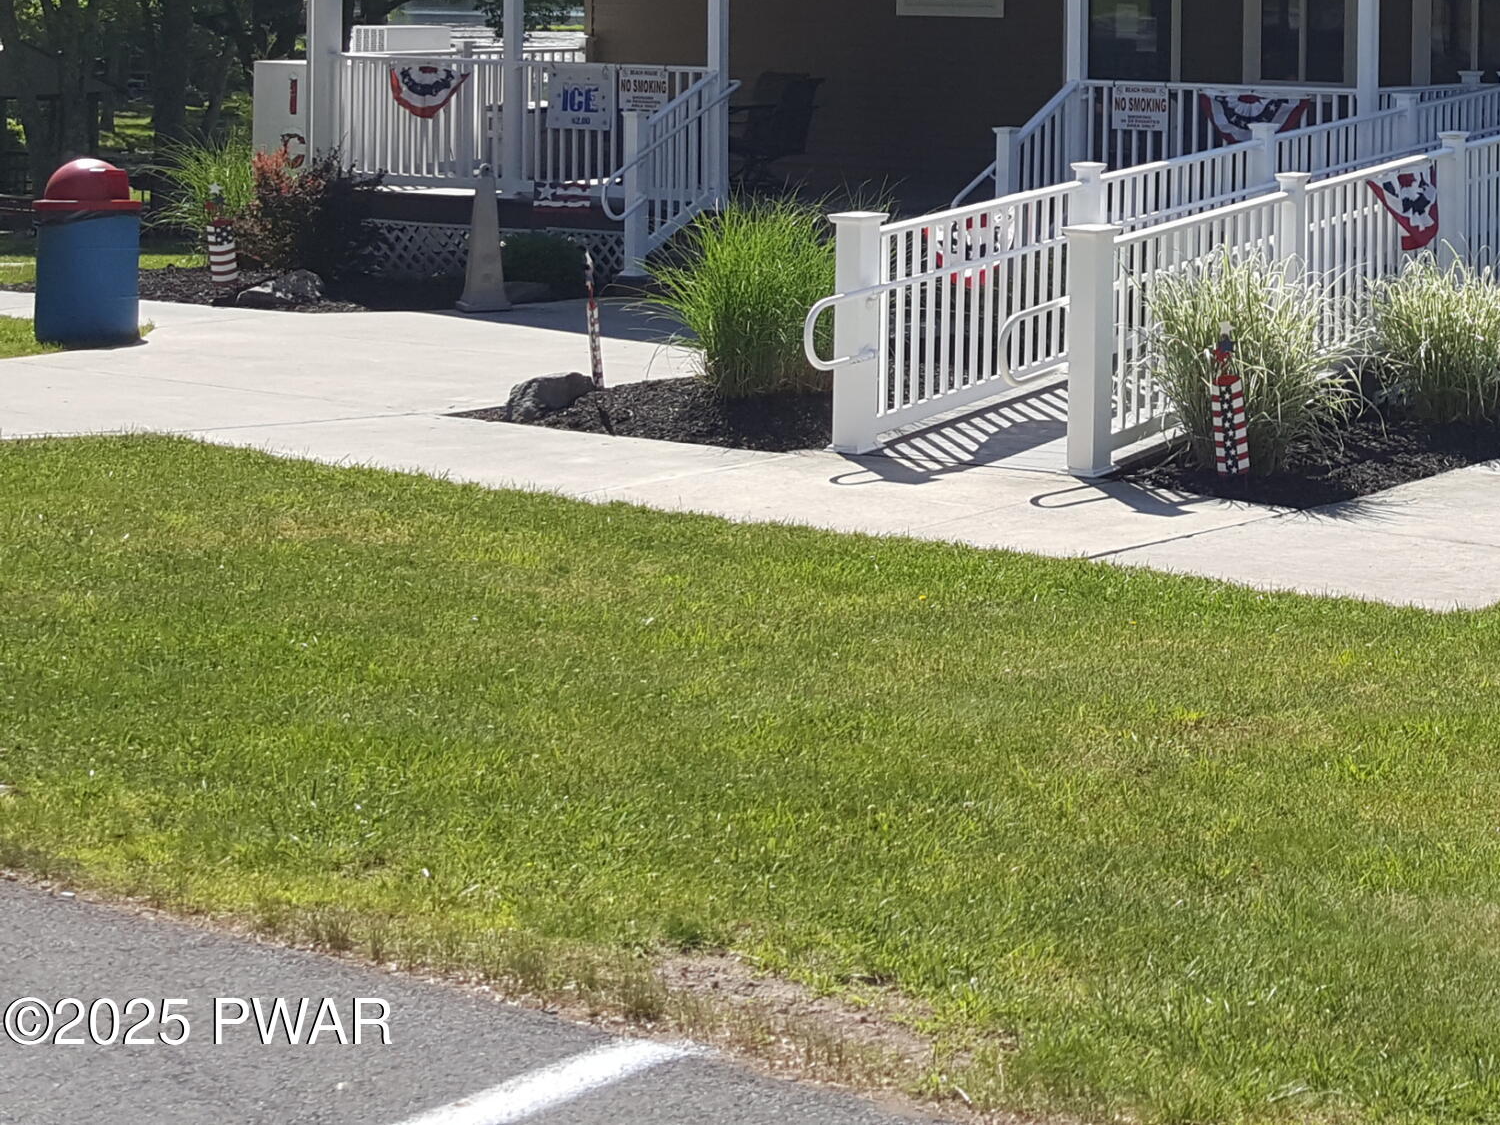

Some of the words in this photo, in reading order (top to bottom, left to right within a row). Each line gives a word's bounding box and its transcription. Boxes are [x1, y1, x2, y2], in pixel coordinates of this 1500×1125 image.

[621, 79, 631, 92] NO
[633, 79, 667, 94] SMOKING
[562, 82, 599, 113] ICE
[1115, 97, 1126, 112] NO
[1129, 97, 1167, 113] SMOKING
